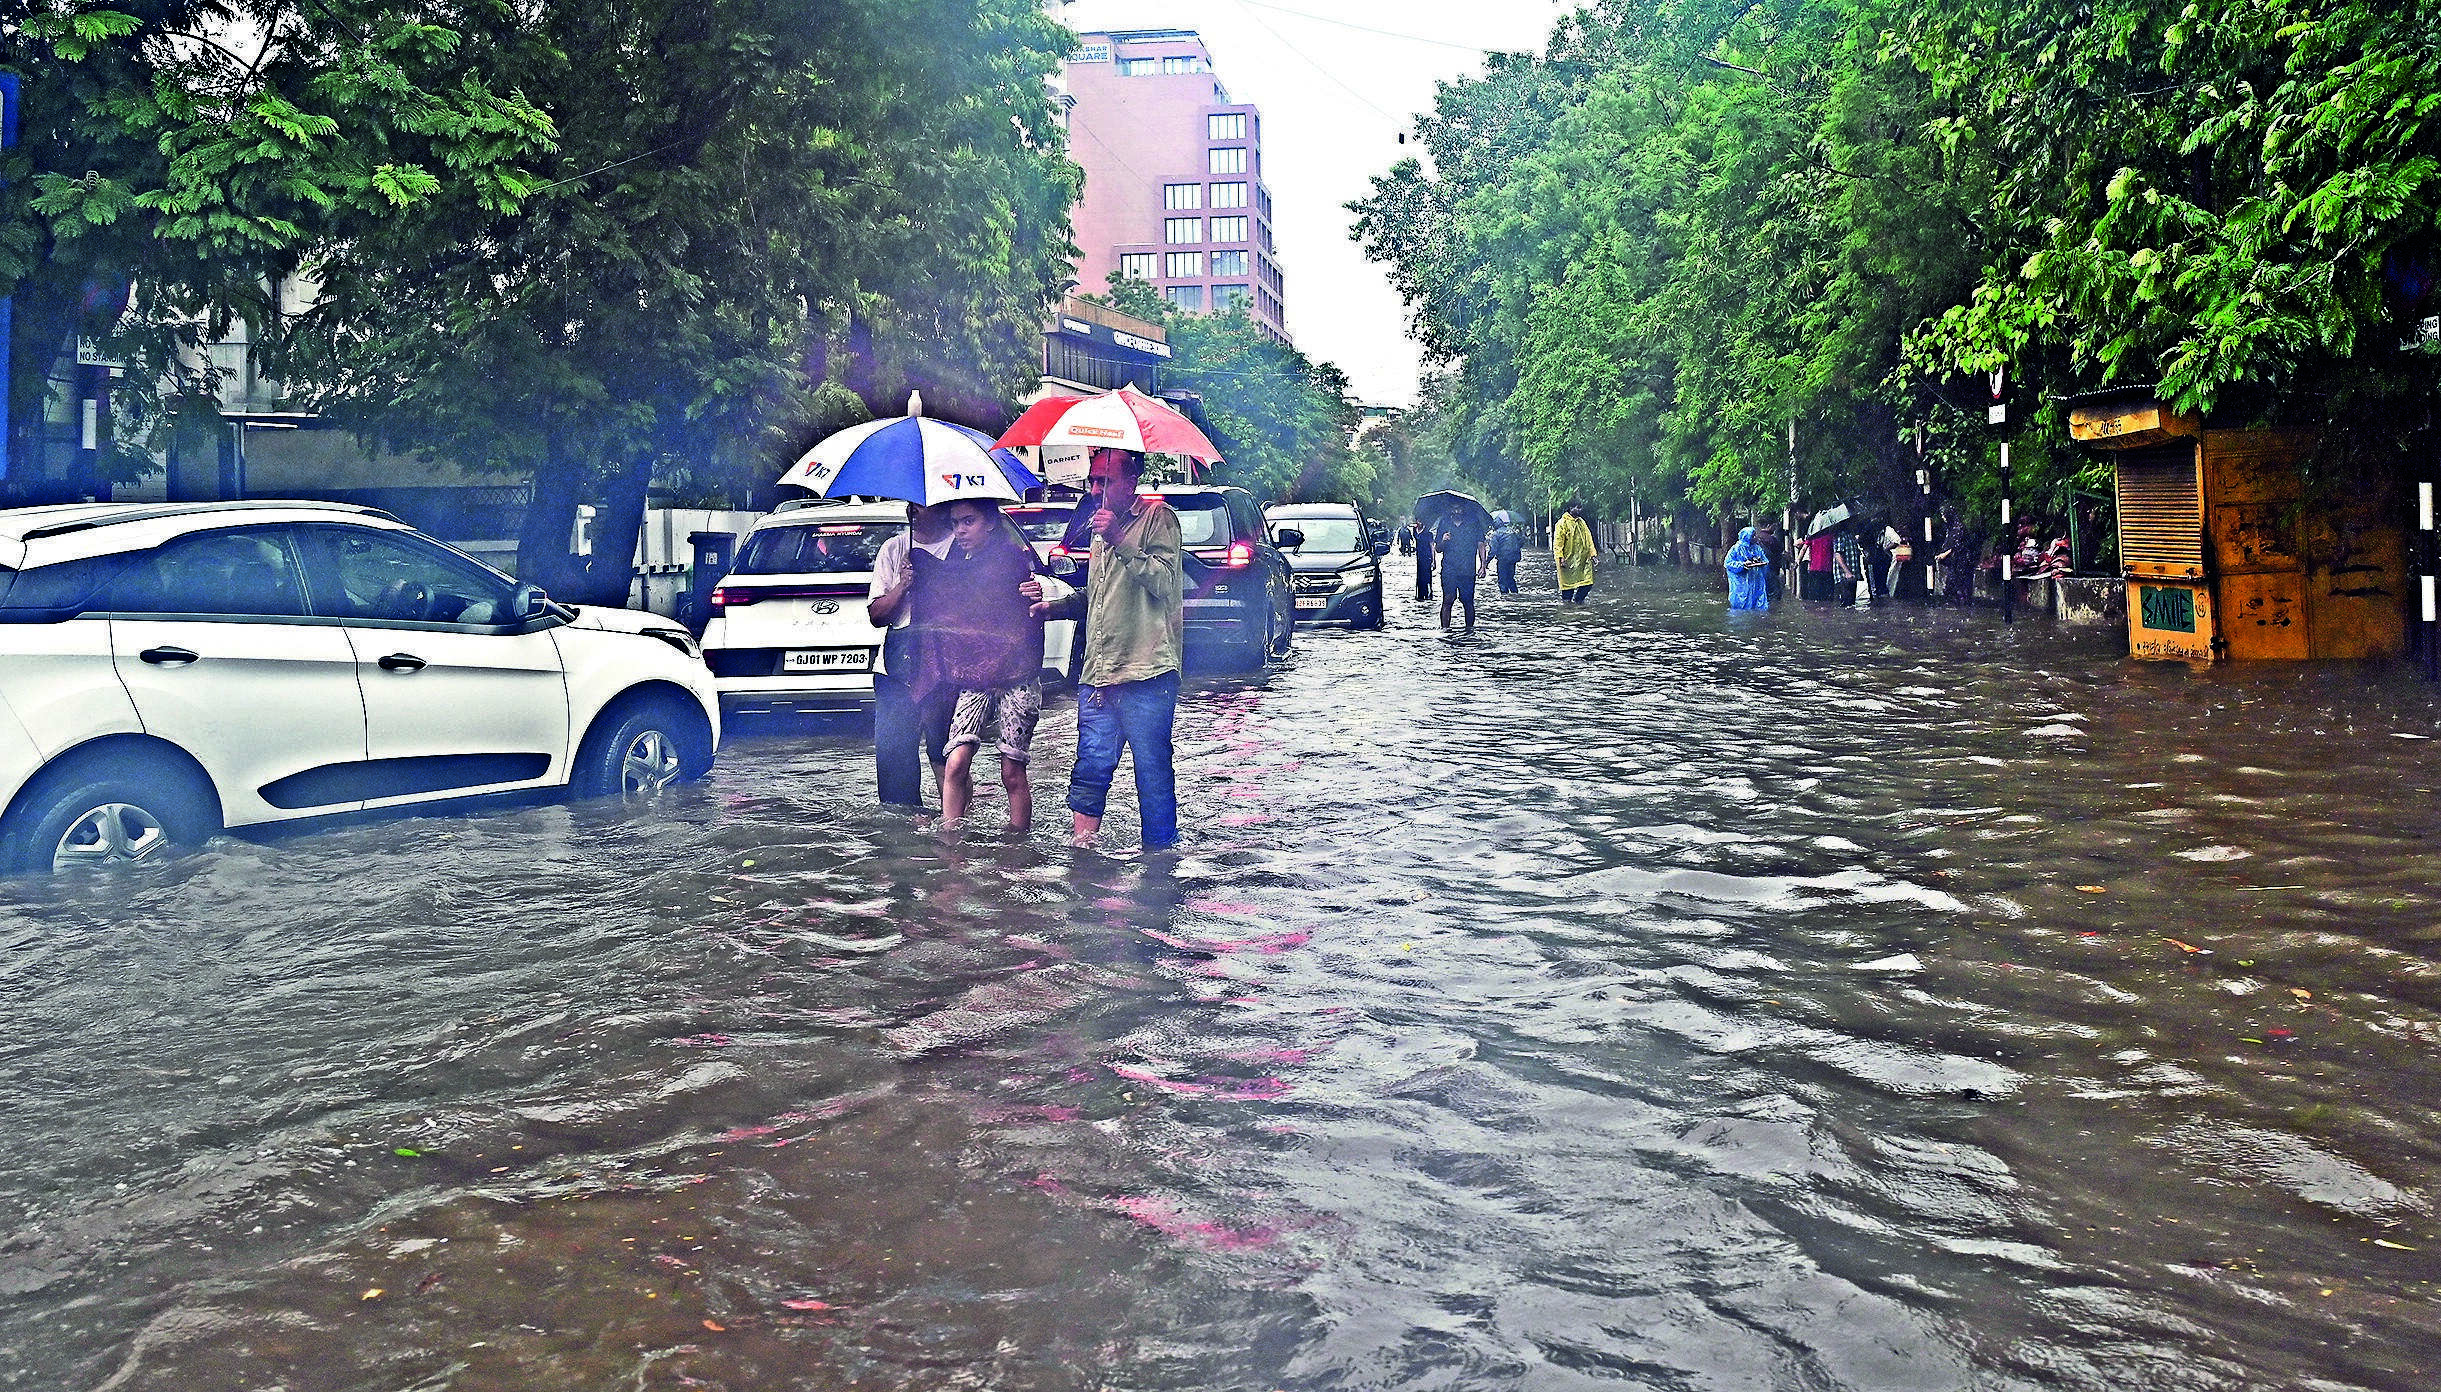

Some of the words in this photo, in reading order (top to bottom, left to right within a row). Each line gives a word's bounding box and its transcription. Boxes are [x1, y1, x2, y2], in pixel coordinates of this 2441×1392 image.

[1067, 52, 1108, 62] QUARE
[80, 351, 91, 361] NO
[966, 475, 985, 486] K7
[796, 654, 820, 664] GJ01
[822, 654, 838, 665] WP
[840, 653, 866, 664] 7203
